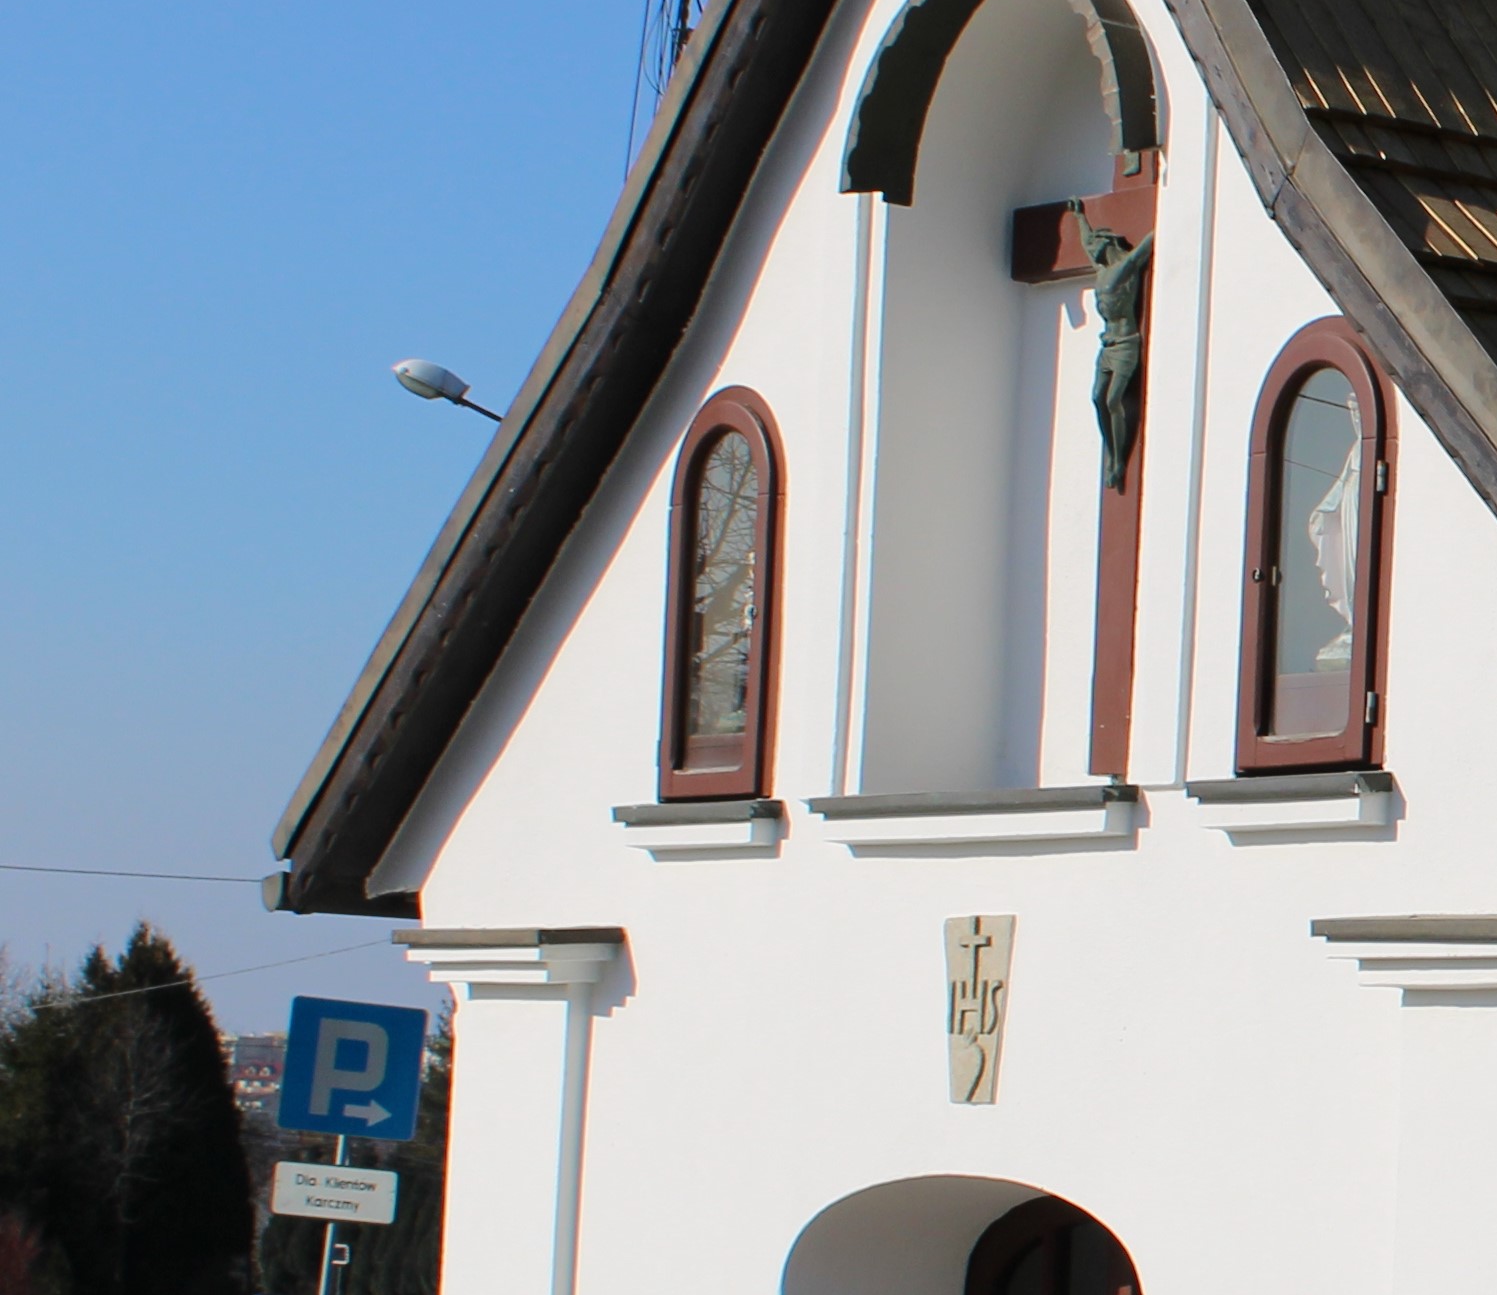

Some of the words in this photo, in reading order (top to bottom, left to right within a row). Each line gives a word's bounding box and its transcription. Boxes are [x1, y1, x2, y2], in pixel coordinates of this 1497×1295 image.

[308, 1017, 389, 1116] P
[295, 1173, 317, 1187] Dla
[304, 1194, 359, 1213] Karczmy
